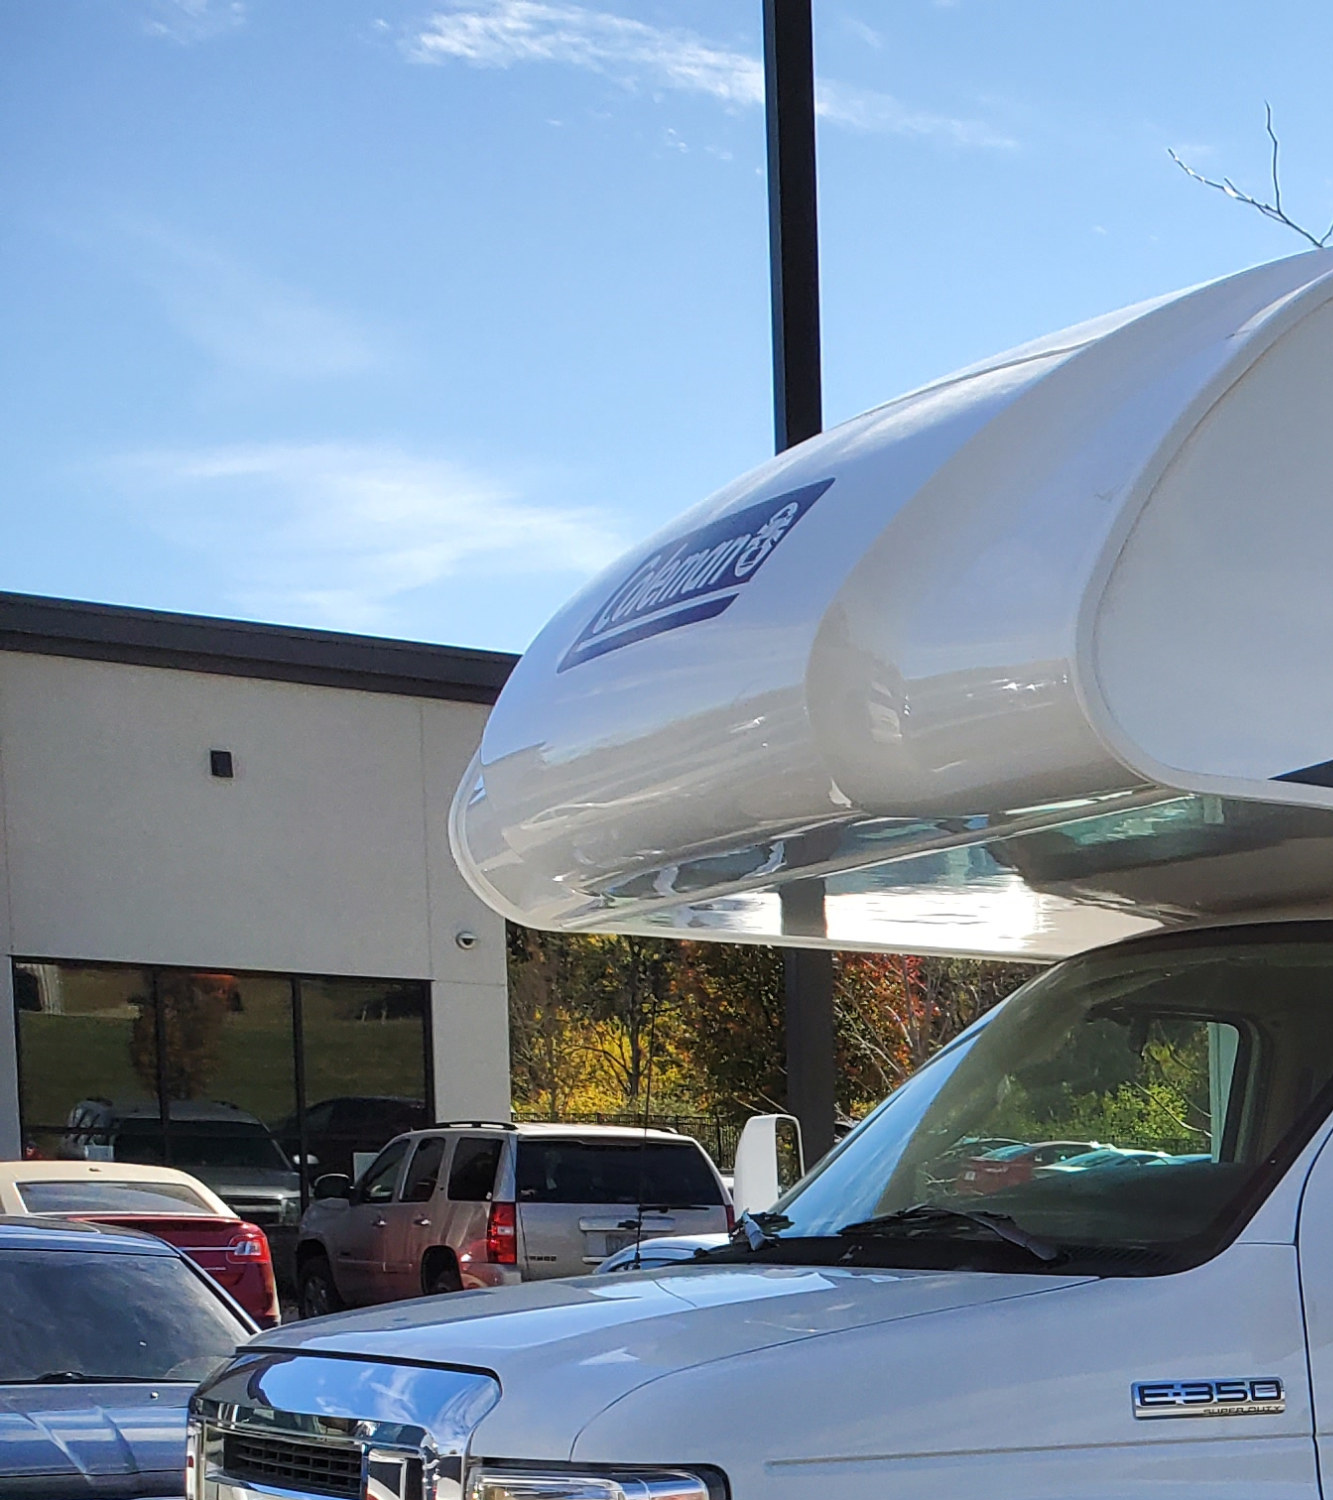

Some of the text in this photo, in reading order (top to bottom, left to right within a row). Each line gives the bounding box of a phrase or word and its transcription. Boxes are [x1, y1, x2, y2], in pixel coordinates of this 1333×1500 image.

[592, 533, 750, 634] Coleman
[1203, 1405, 1281, 1417] SUPER DUTY
